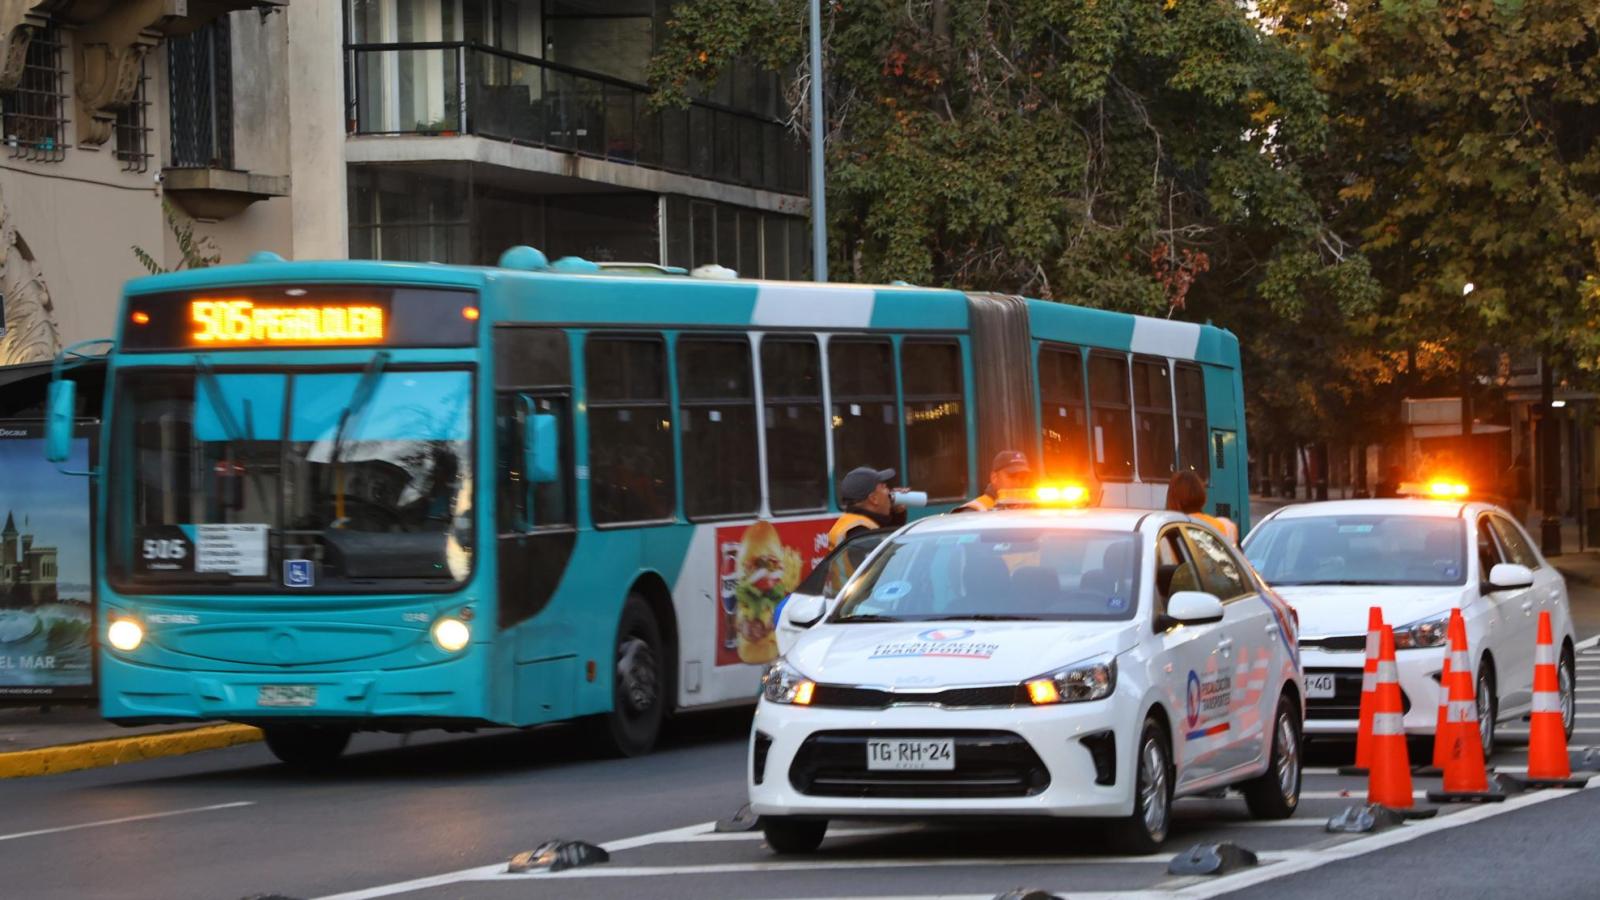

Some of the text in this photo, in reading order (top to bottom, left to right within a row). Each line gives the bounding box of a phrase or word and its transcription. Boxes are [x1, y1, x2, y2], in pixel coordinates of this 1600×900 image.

[192, 300, 253, 341] 505
[142, 538, 187, 560] 505
[19, 655, 56, 669] MAR
